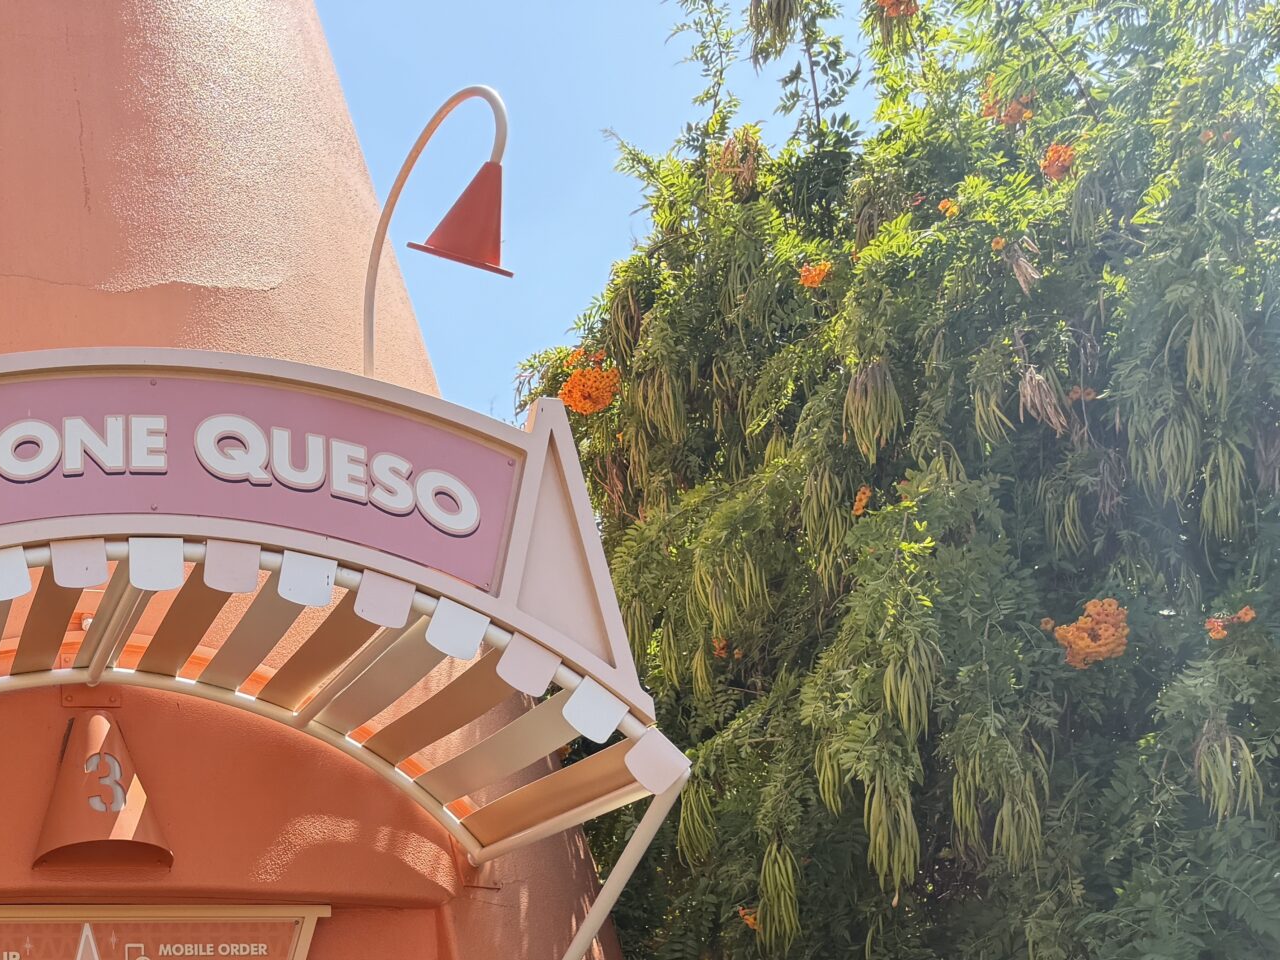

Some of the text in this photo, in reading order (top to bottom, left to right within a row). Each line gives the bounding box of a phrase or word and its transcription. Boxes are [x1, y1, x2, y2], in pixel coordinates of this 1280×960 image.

[194, 413, 480, 537] QUESO
[85, 752, 127, 812] 3
[158, 943, 268, 956] MOBILE ORDER
